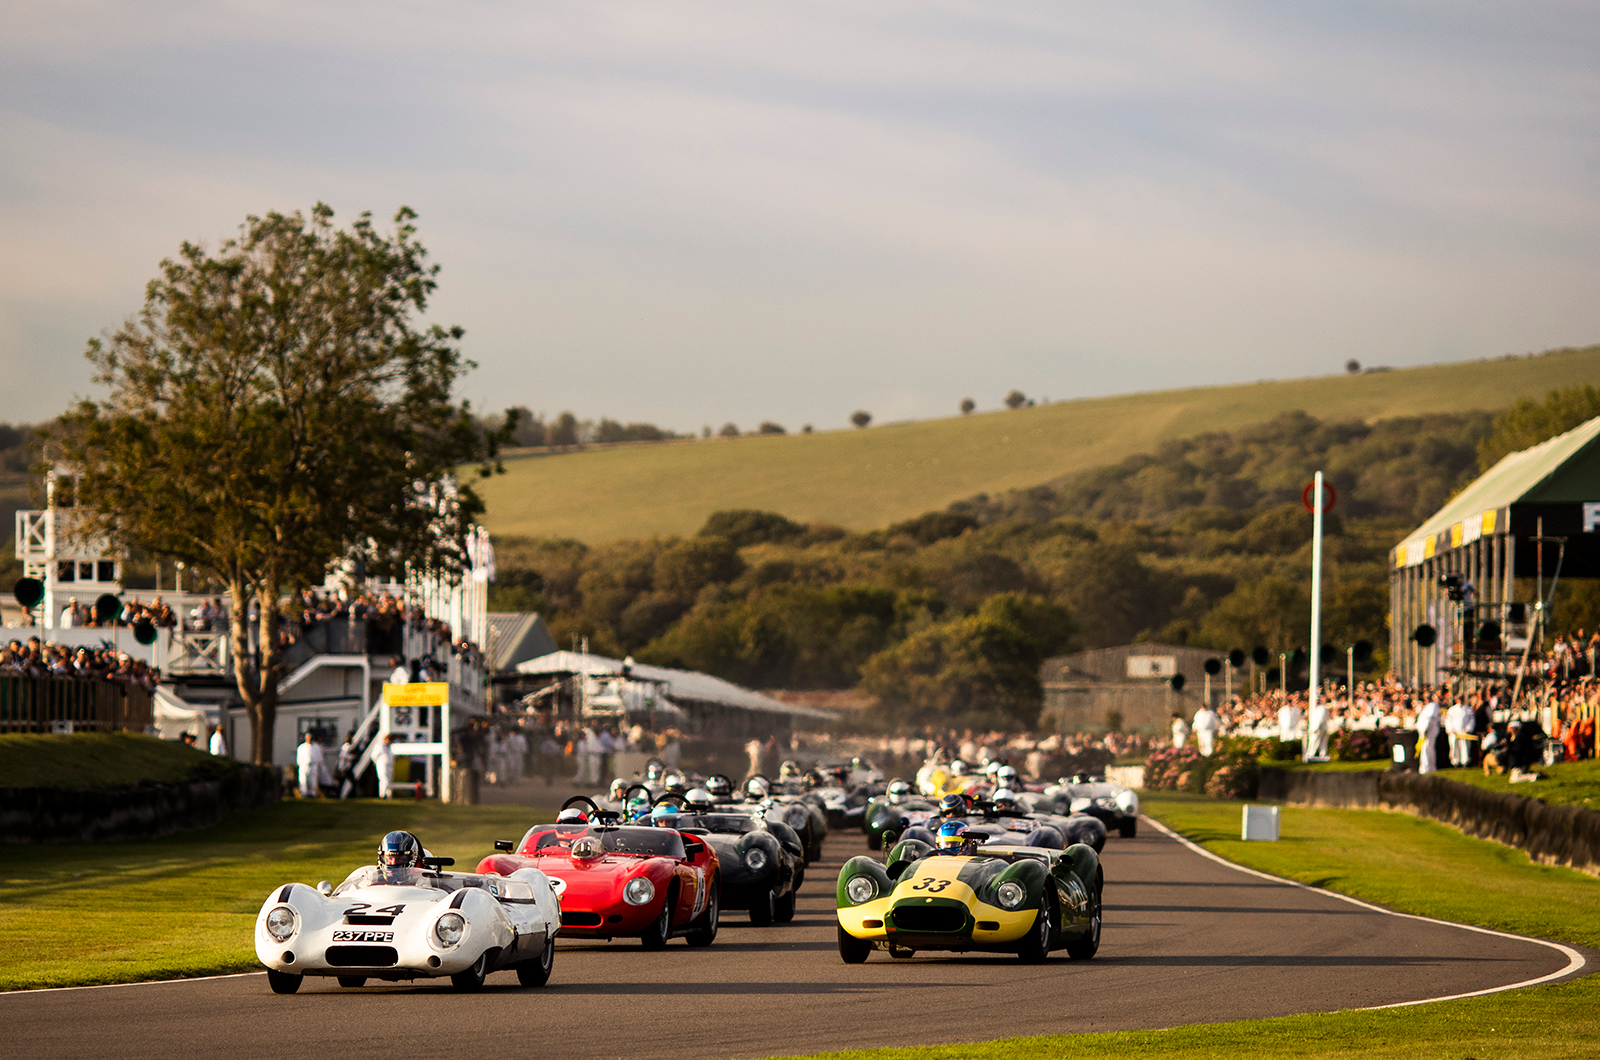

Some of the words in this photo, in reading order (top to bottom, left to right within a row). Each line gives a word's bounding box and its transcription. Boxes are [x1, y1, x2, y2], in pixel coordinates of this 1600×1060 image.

[912, 877, 952, 893] 33
[343, 903, 406, 916] 24
[333, 931, 393, 942] 237PPE
